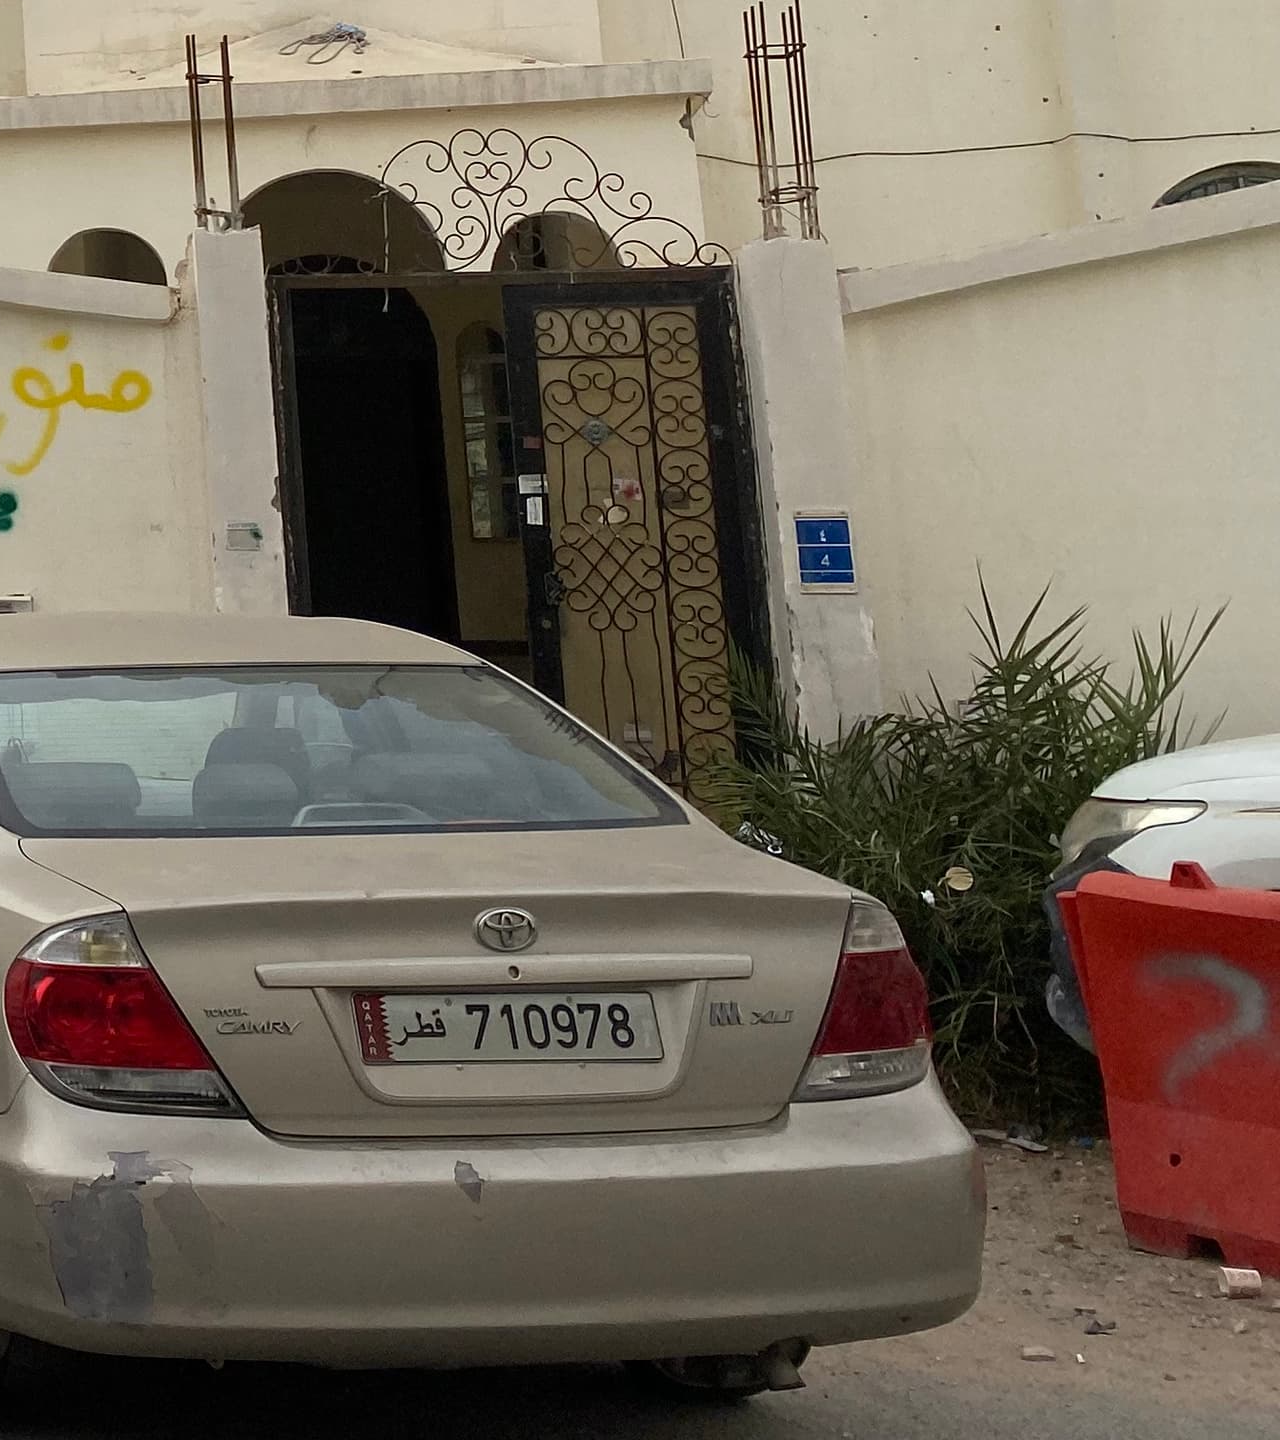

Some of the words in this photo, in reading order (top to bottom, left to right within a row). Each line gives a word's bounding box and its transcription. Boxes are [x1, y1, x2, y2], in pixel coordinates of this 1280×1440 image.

[820, 553, 830, 567] 4
[203, 1007, 249, 1018] TOYOTA
[216, 1020, 302, 1035] CAMRY
[361, 1000, 378, 1056] QATAR
[392, 1008, 447, 1047] قطر
[464, 1003, 636, 1050] 710978
